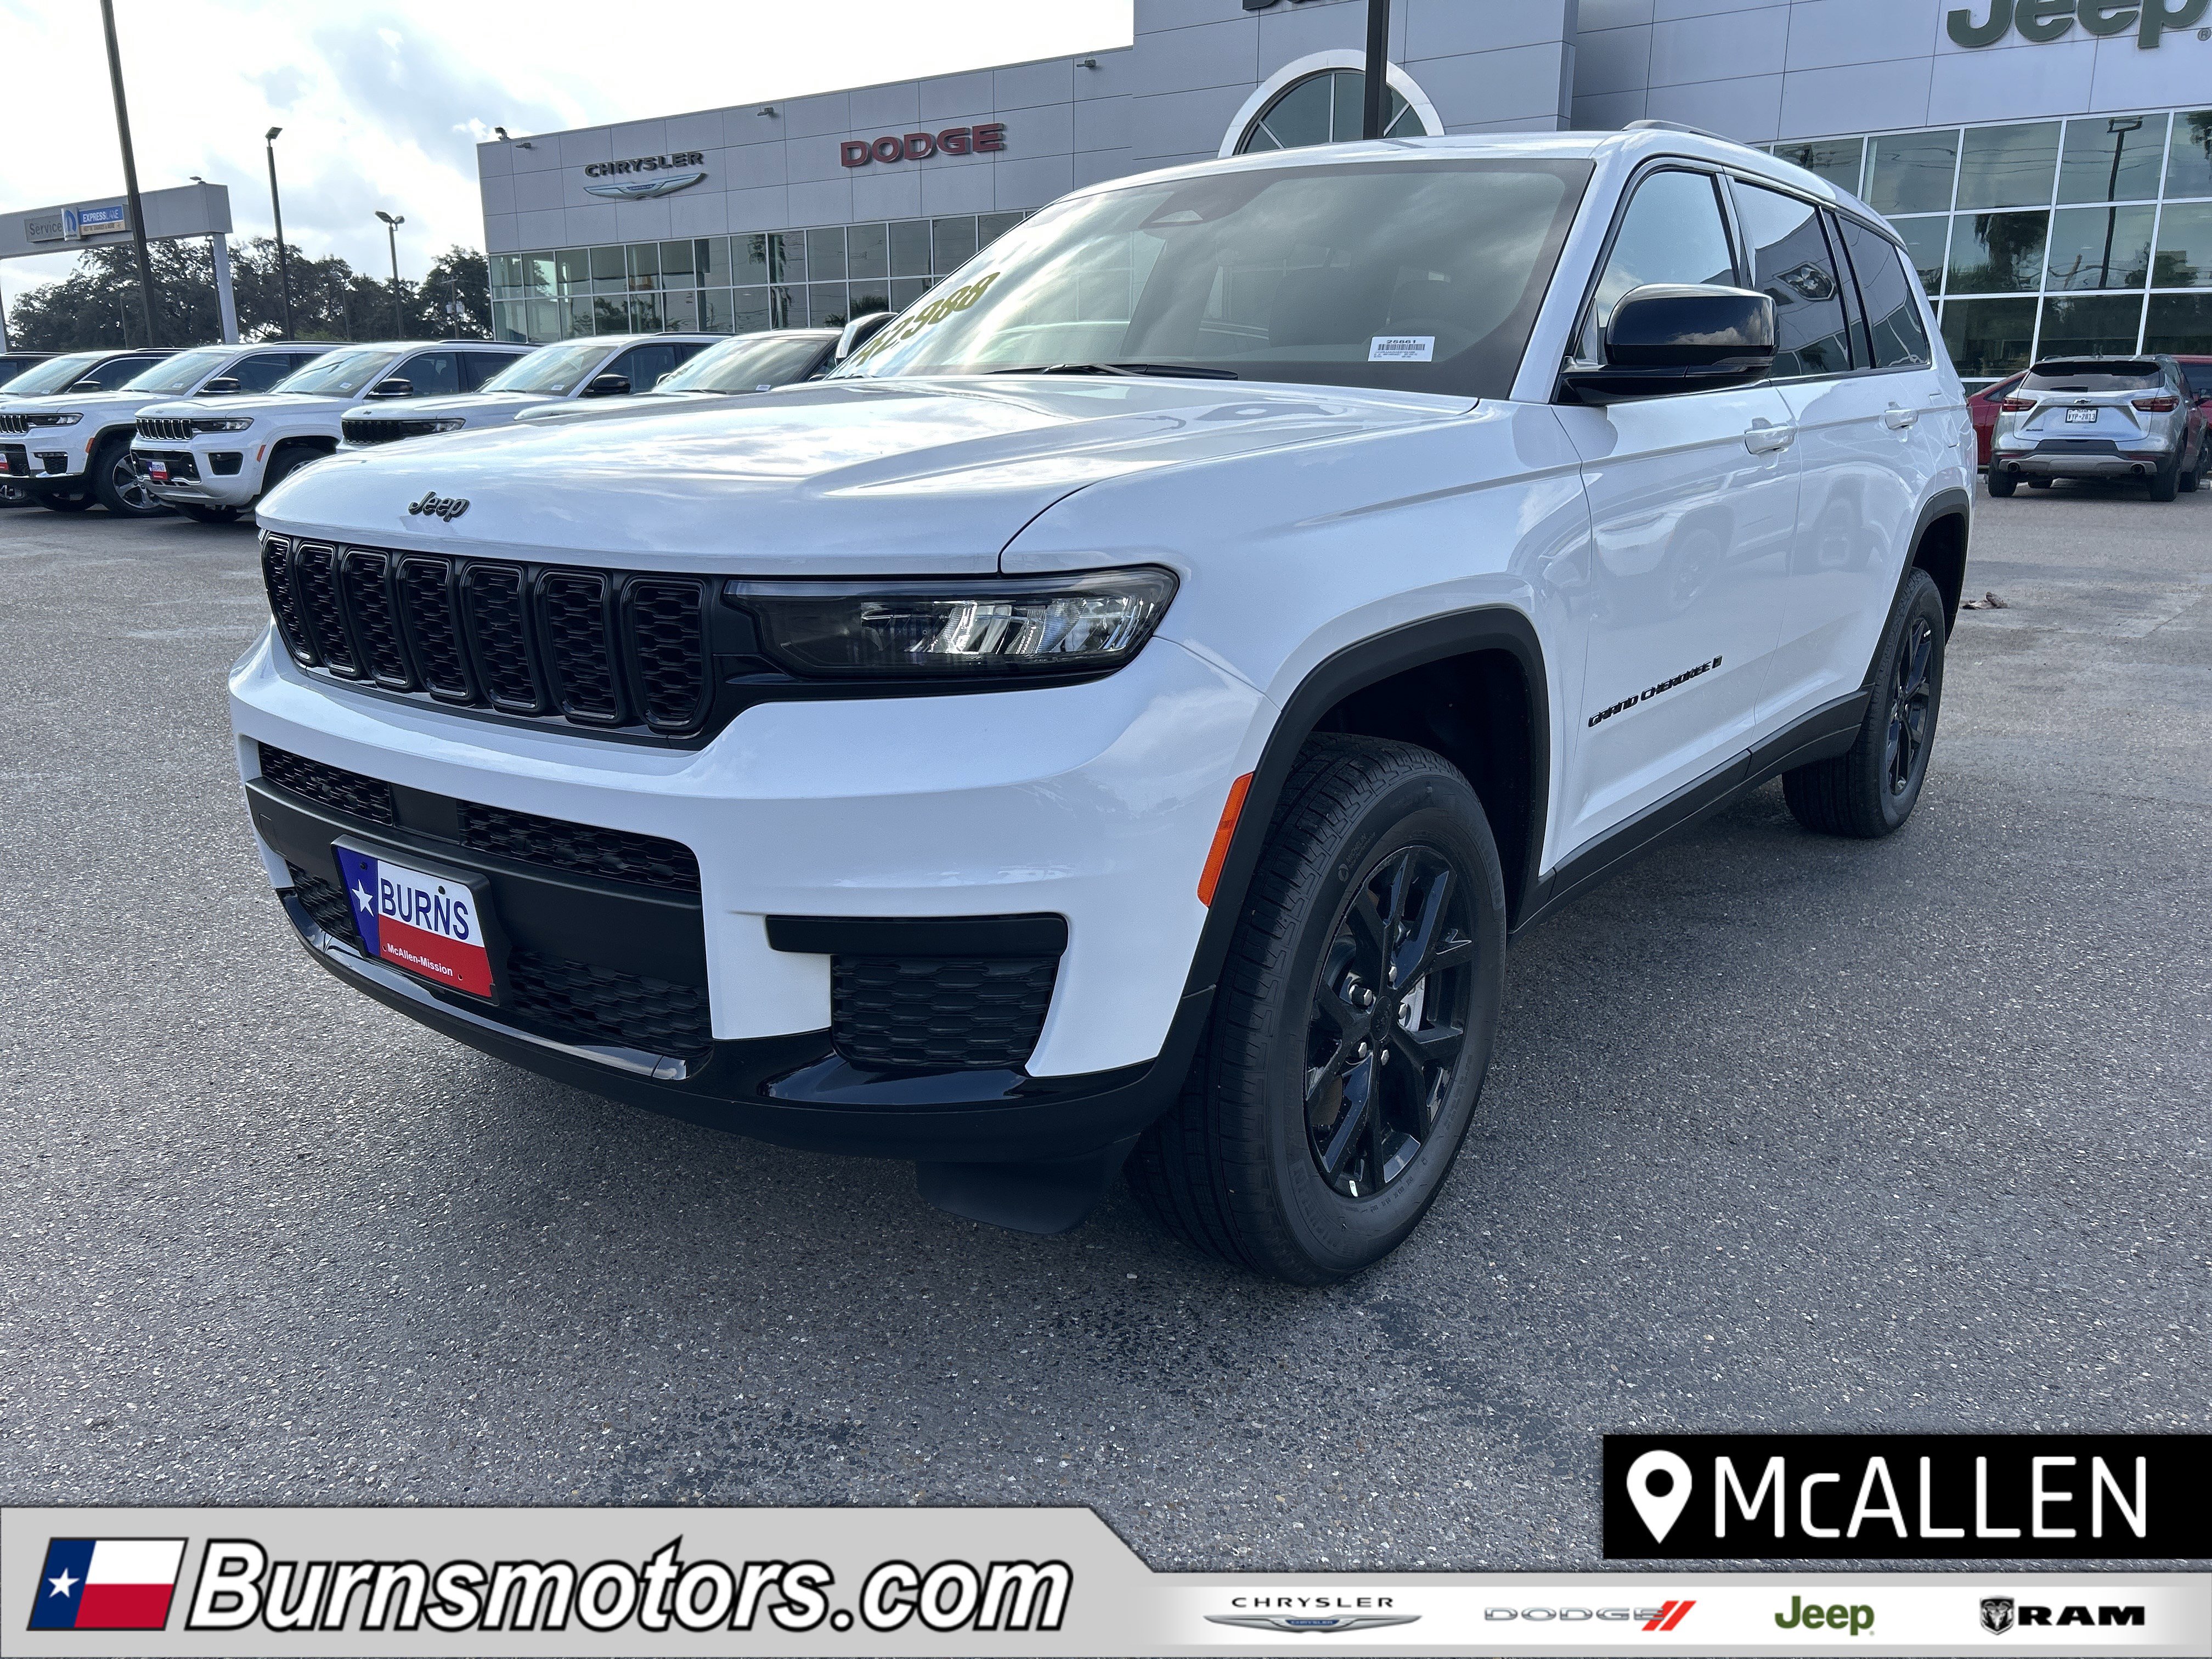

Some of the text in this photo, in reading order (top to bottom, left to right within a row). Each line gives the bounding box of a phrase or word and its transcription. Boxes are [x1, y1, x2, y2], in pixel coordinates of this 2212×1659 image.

[1946, 0, 2210, 49] Jeep
[585, 152, 704, 177] CHRYSLER
[840, 123, 1005, 167] DODGE
[29, 222, 63, 235] Service
[408, 491, 470, 522] Jeep
[1588, 694, 1639, 727] GRAND
[1641, 661, 1711, 701] CHEROKEE
[380, 878, 469, 940] BURNS
[387, 943, 453, 977] McAllen-Mission
